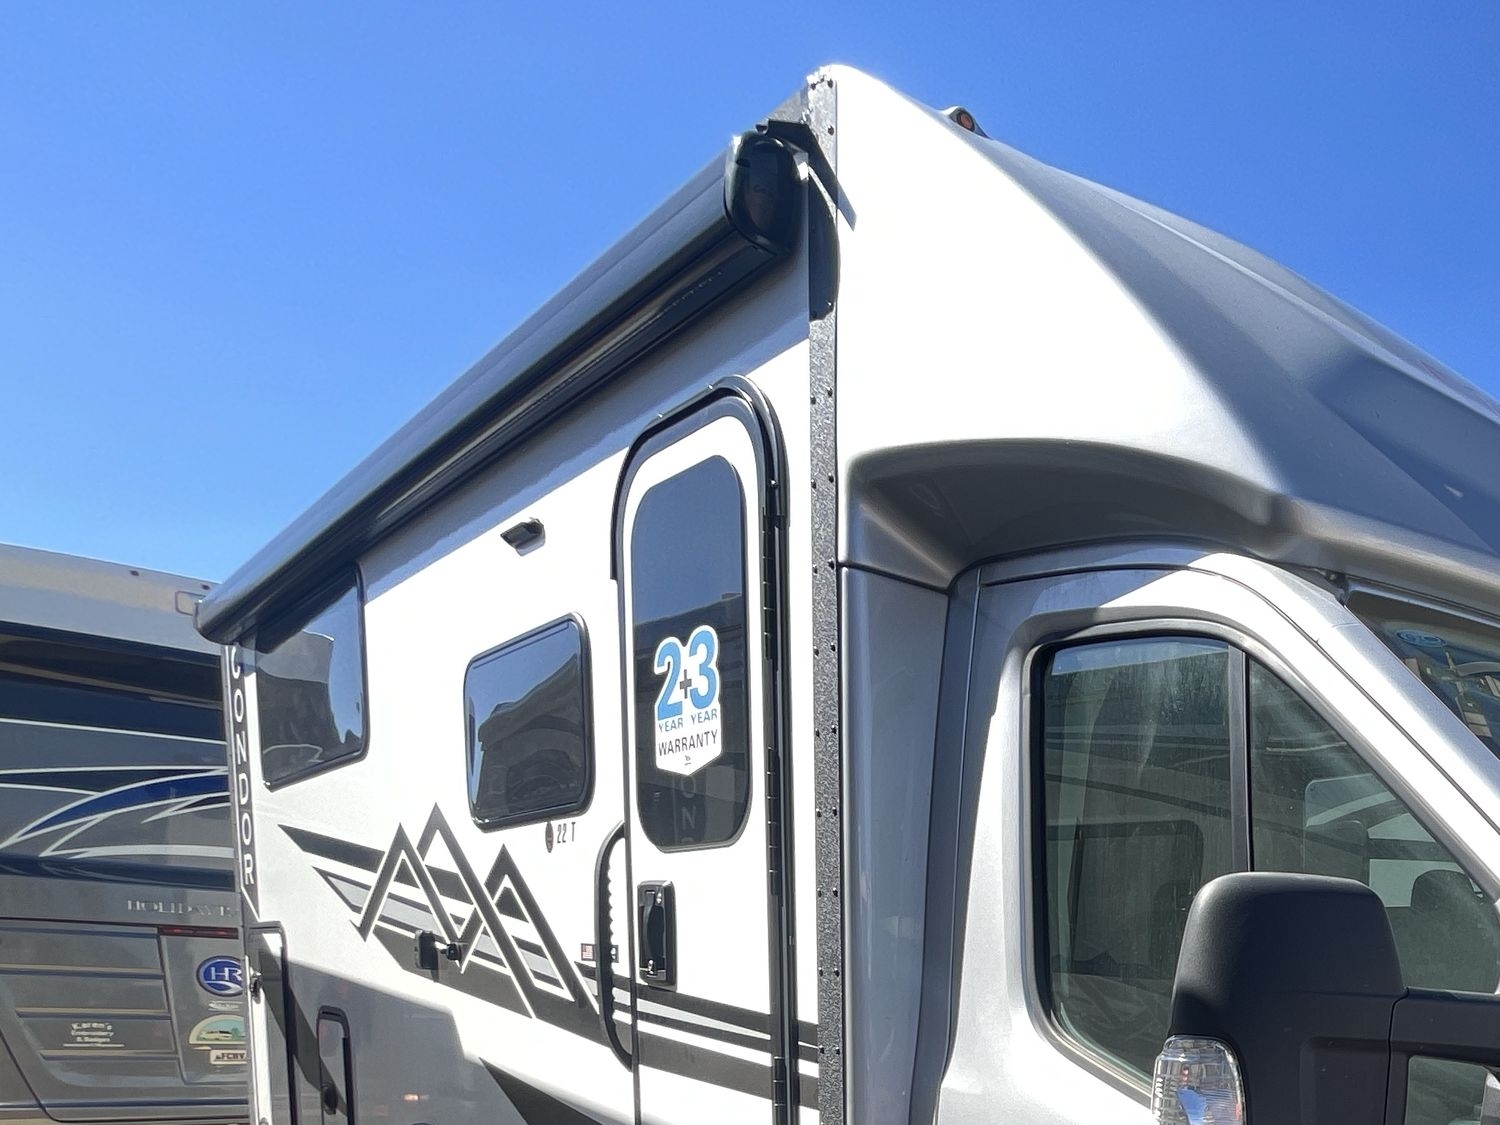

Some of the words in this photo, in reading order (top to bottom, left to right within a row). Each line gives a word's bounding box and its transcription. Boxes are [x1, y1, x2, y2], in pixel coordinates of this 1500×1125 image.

[658, 717, 684, 733] YEAR
[690, 708, 718, 725] YEAR
[658, 728, 719, 757] WARRANTY
[230, 646, 256, 885] CONDOR
[210, 966, 243, 981] HR
